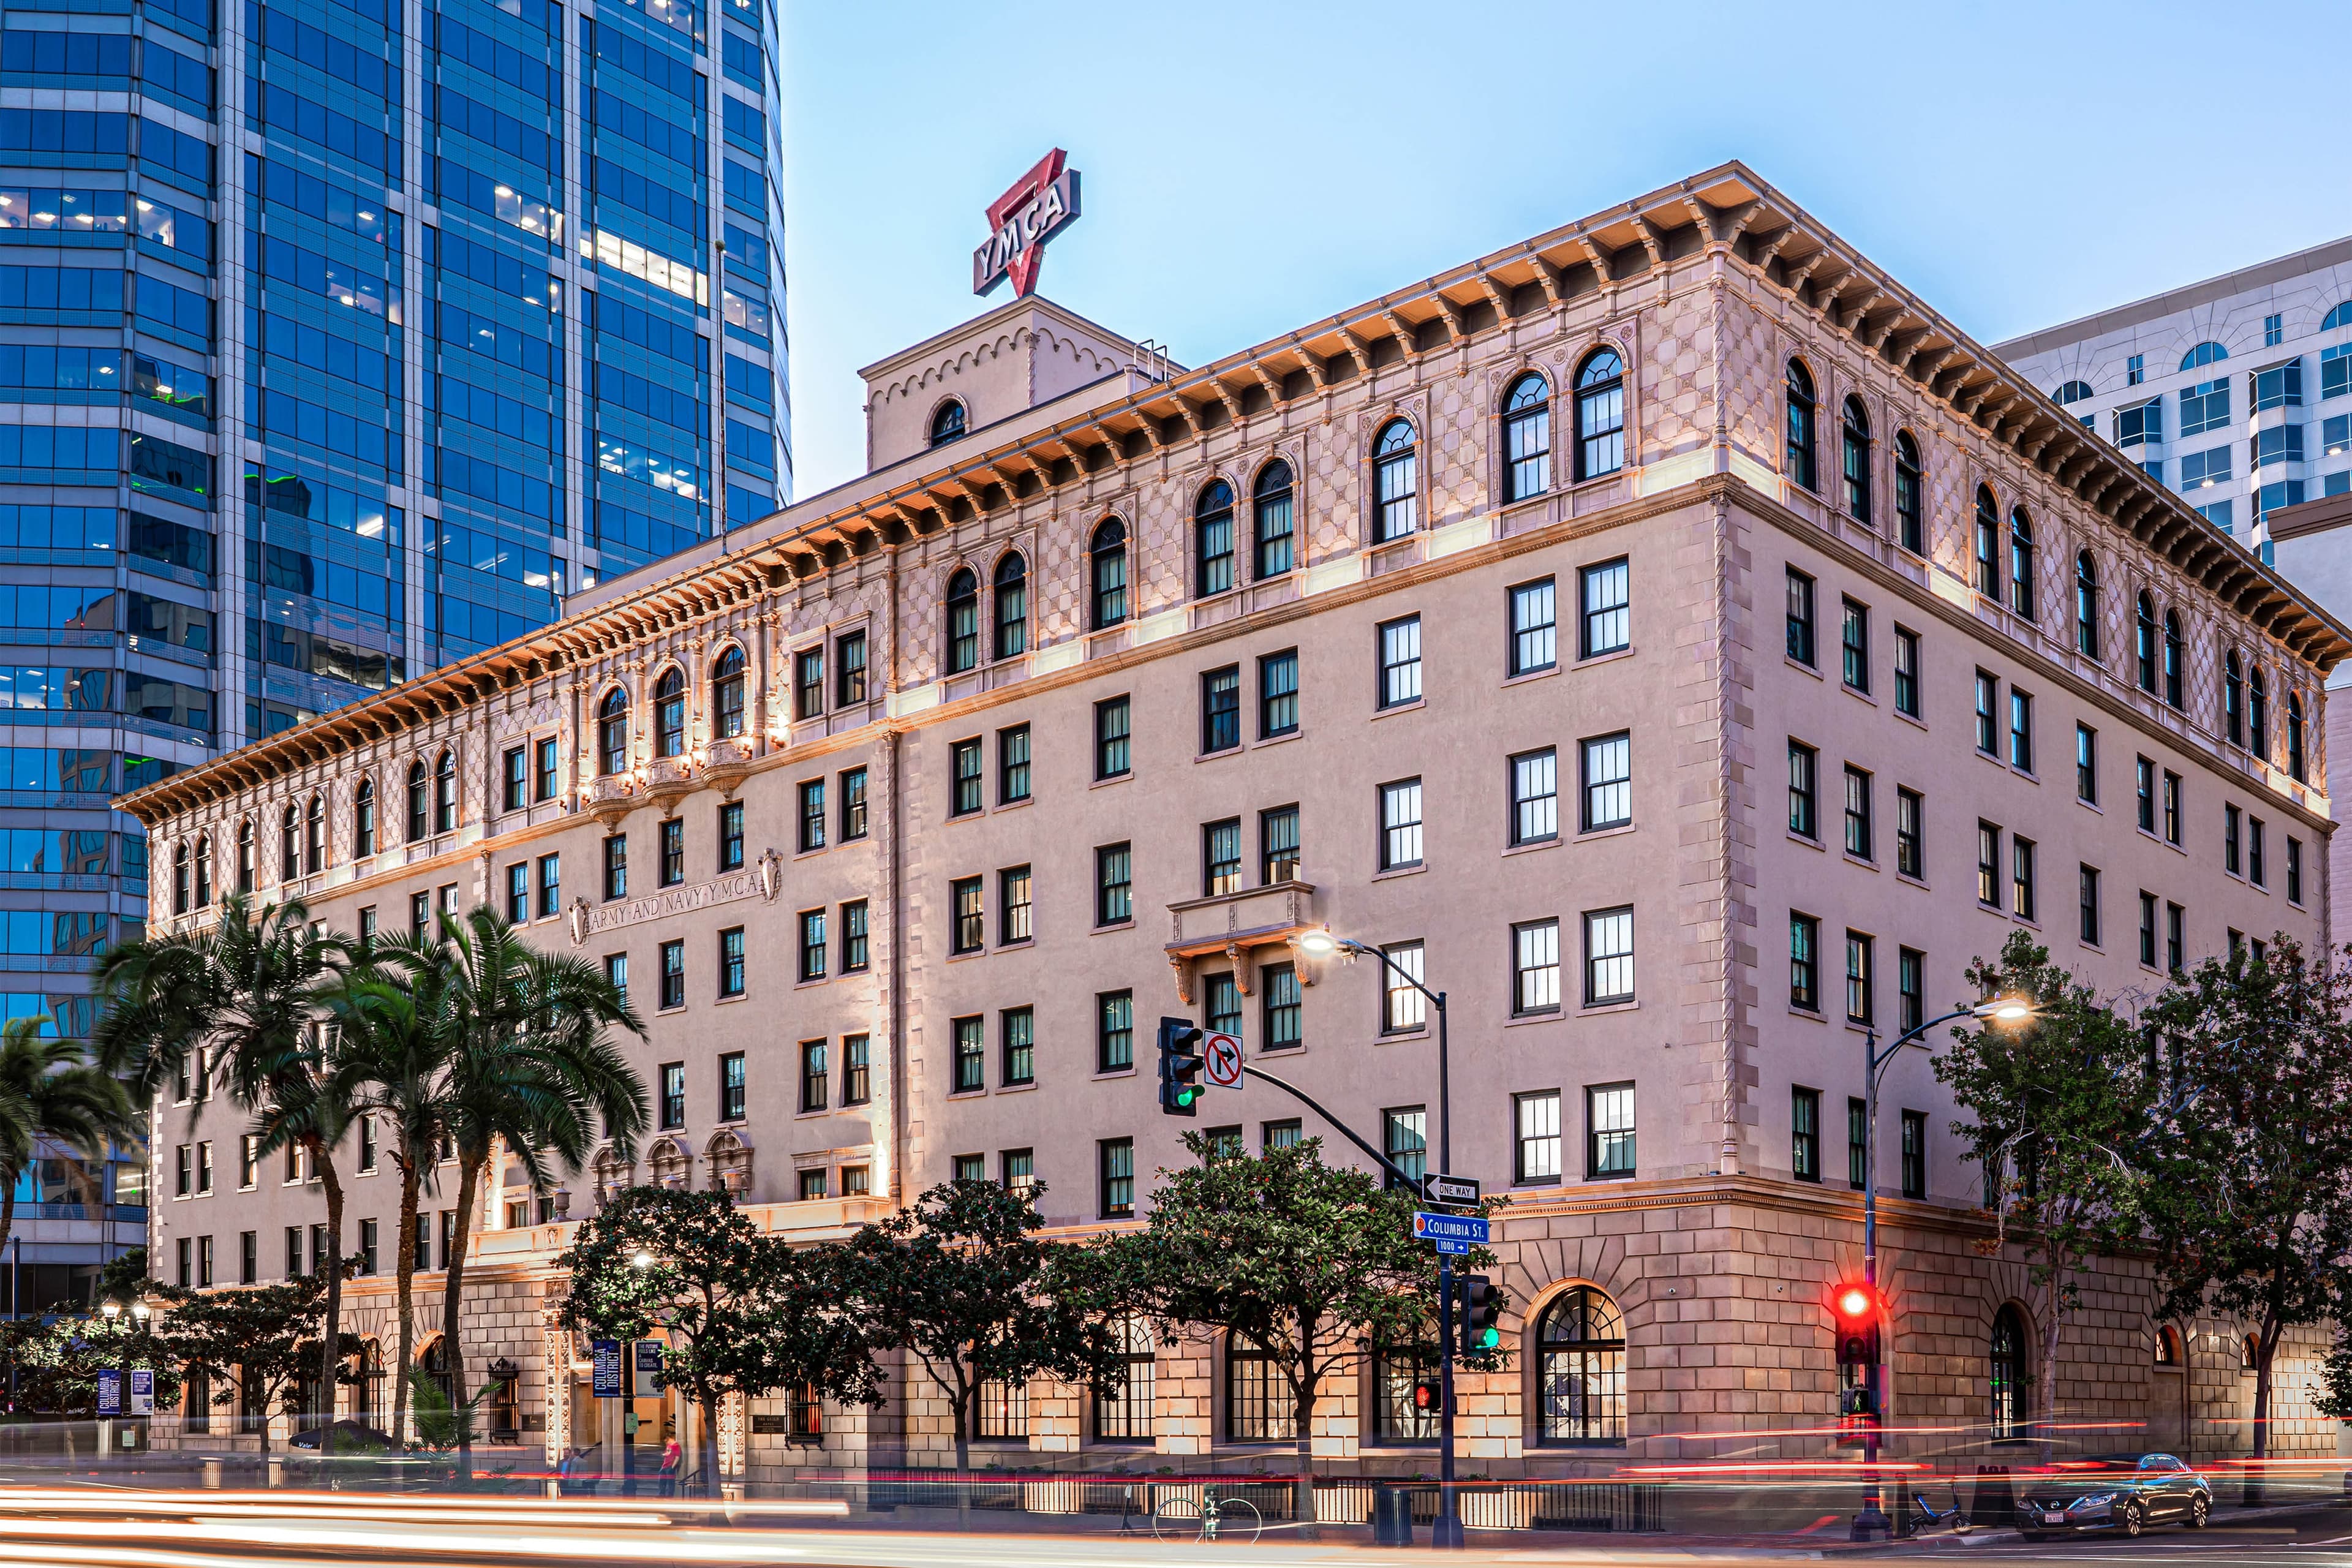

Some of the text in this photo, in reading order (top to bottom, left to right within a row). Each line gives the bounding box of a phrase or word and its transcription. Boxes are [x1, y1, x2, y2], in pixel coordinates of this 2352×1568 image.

[977, 183, 1065, 280] YMCA
[590, 906, 627, 930] ARMY
[633, 899, 659, 919] AND
[666, 887, 702, 912] NAVY
[1439, 1184, 1471, 1196] ONE WAY
[1428, 1218, 1484, 1238] COLUMBIA ST.
[1440, 1240, 1455, 1251] 1000
[606, 1351, 619, 1387] DISTRICT
[99, 1377, 110, 1409] COLUMBIA
[110, 1379, 120, 1407] DISTRICT
